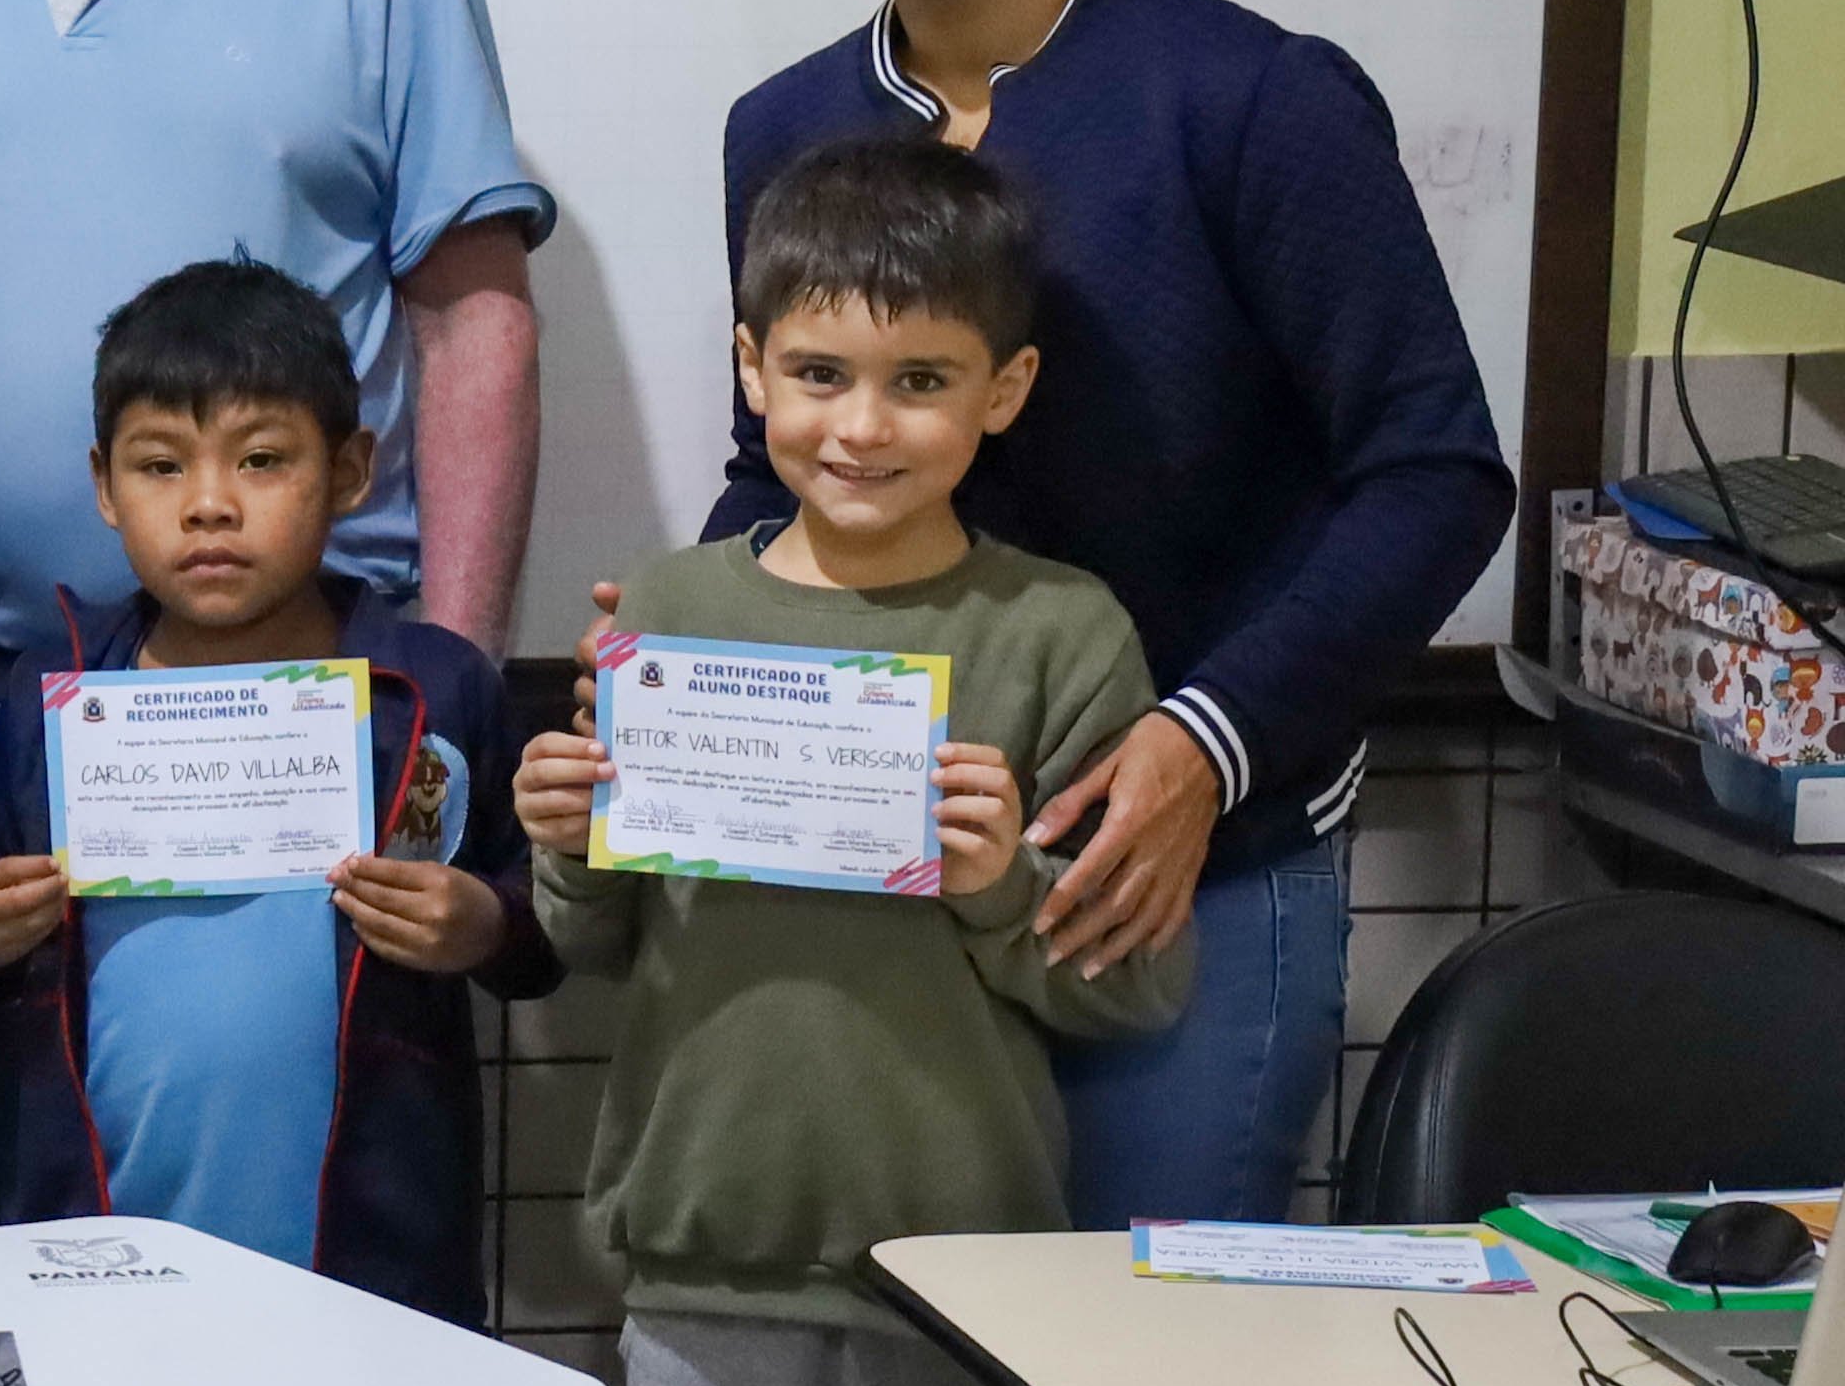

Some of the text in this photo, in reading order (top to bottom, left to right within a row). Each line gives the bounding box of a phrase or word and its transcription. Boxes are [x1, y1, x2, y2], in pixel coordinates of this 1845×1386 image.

[693, 663, 828, 686] CERTIFICADO DE
[134, 688, 259, 706] CERTIFICADO DE
[688, 680, 832, 704] ALUNO DESTAQUE
[126, 703, 268, 723] RECONHECIMENTO
[615, 727, 678, 749] HEITOR
[689, 733, 779, 760] VALENTIN
[827, 746, 925, 772] VERISSIMO
[81, 754, 341, 786] CARLOS DAVID VILLALBA
